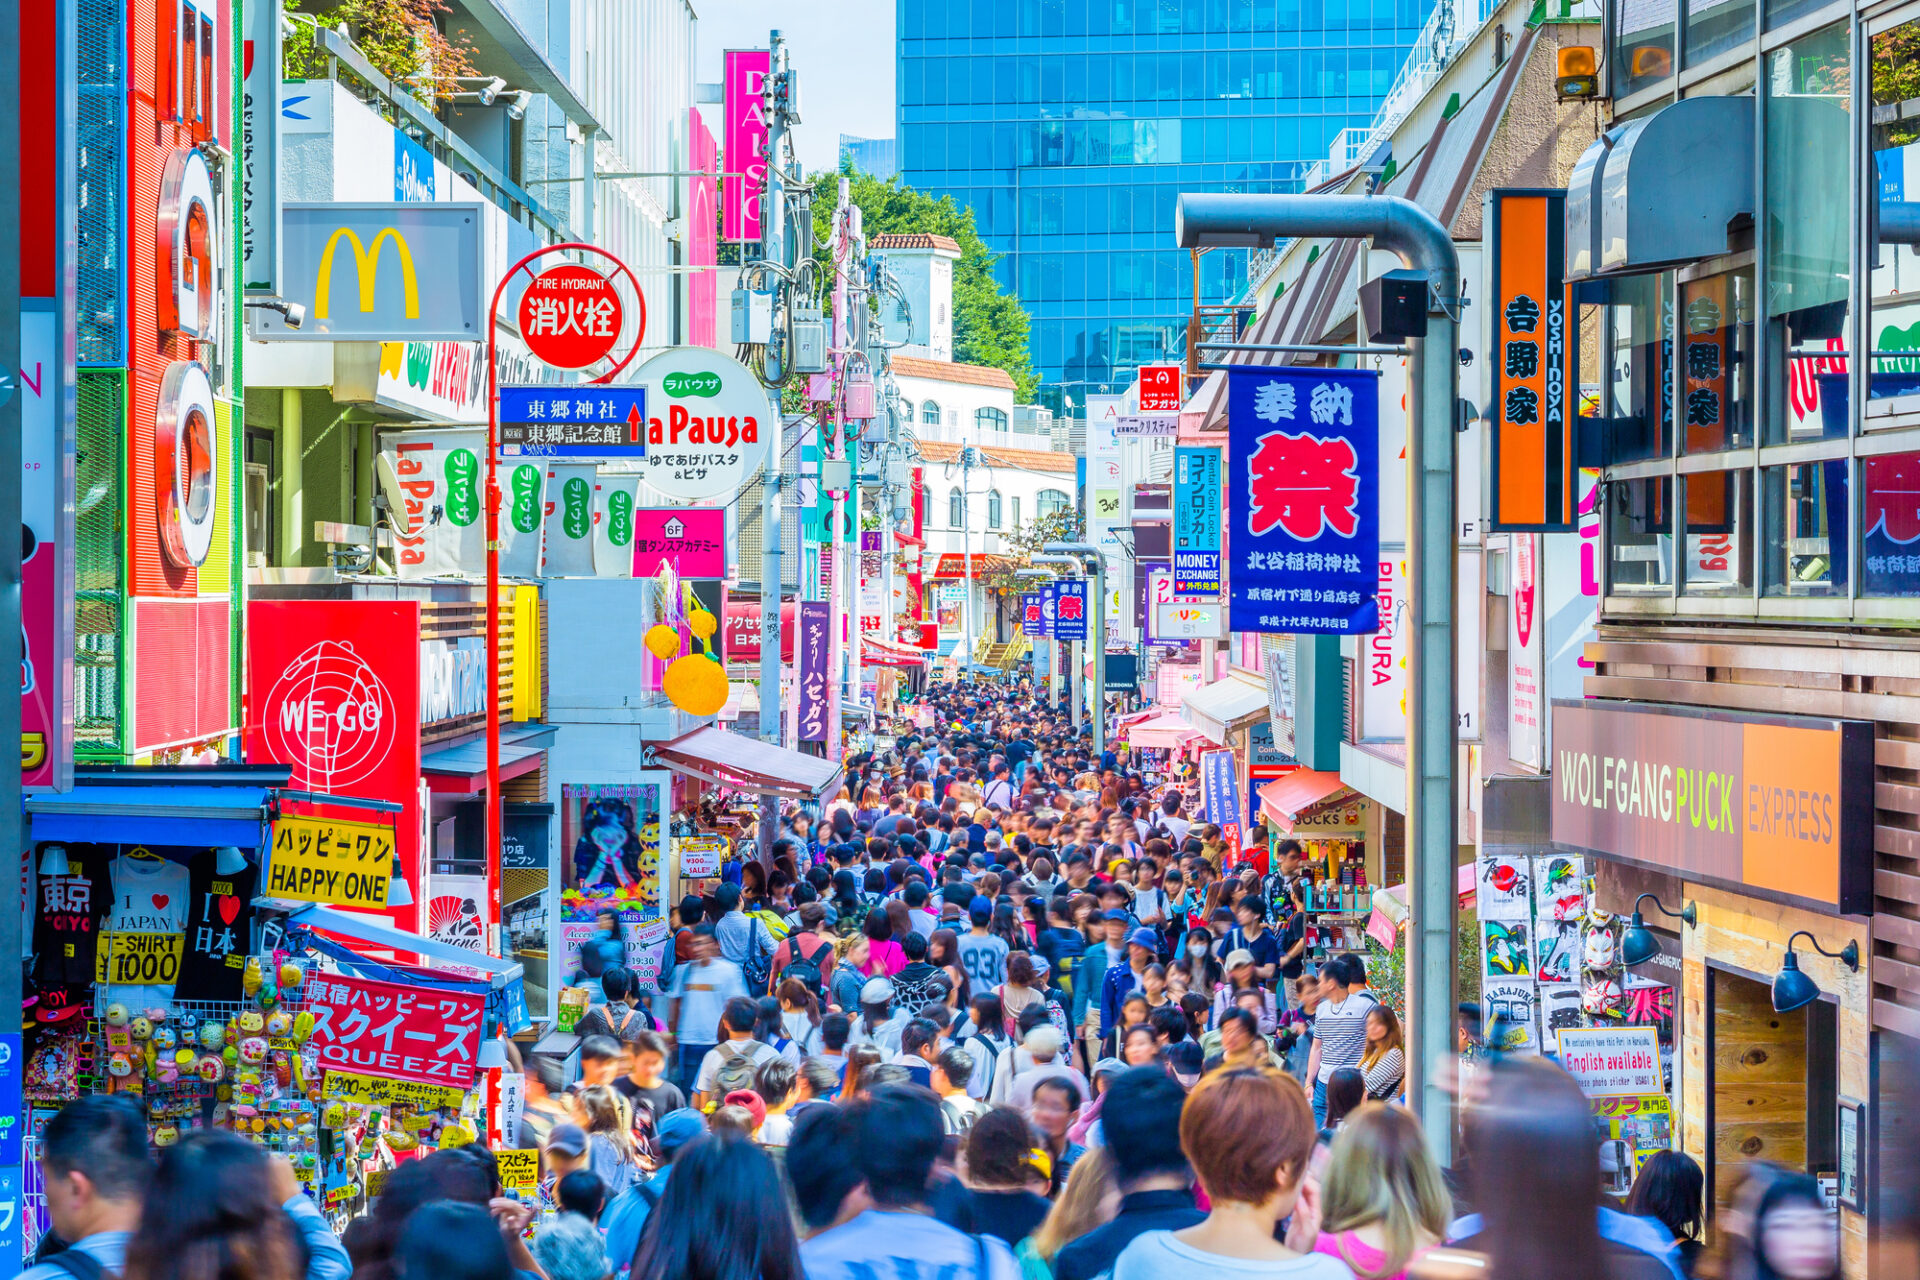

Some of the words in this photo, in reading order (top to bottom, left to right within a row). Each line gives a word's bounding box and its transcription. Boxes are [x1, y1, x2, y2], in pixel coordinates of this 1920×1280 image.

[536, 278, 558, 290] FIRE
[560, 278, 605, 291] HYDRANT
[528, 297, 615, 337] 消火栓
[1548, 300, 1562, 422] YOSHINOYA
[665, 378, 719, 391] ラパウザ
[527, 400, 617, 419] 東郷神社
[1149, 399, 1178, 409] アガサ
[1254, 380, 1354, 426] 奉納
[528, 423, 622, 444] 東郷記念館
[649, 417, 663, 445] a
[669, 404, 758, 448] Pausa
[650, 454, 739, 466] ゆであげパスタ
[674, 469, 708, 480] &ピザ
[1208, 455, 1216, 486] Rental
[453, 452, 471, 524] ラパウザ
[520, 468, 533, 531] ラパウザ
[1192, 455, 1205, 547] コインロッカー
[1208, 489, 1216, 511] Coin
[1247, 430, 1361, 542] 祭
[570, 480, 582, 537] ラパウザ
[615, 493, 625, 545] ラパウザ
[667, 526, 681, 535] 6F
[1208, 514, 1216, 547] Locker
[1177, 554, 1218, 568] MONEY
[1177, 570, 1219, 580] EXCHANGE
[1247, 551, 1361, 574] 北谷稲荷神社
[1247, 588, 1361, 605] 原宿竹下通り商店会
[282, 701, 325, 732] WE
[336, 701, 380, 732] GO
[802, 672, 825, 738] ハセガワ
[1560, 750, 1672, 822] WOLFGANG
[1676, 767, 1734, 834] PUCK
[1749, 784, 1833, 845] EXPRESS
[276, 827, 391, 863] ハッピーワン
[41, 874, 92, 913] 東京
[271, 864, 339, 897] HAPPY
[344, 872, 387, 903] ONE
[123, 895, 131, 909] I
[117, 915, 171, 930] JAPAN
[103, 935, 176, 951] T-SHIRT
[195, 926, 236, 955] 日本
[962, 949, 1000, 979] 93
[306, 980, 479, 1021] 原宿ハッピーワン
[1485, 986, 1535, 1005] HARAJUKU
[307, 1004, 477, 1062] スクイーズ
[307, 1043, 472, 1080] SQUEEZE
[1566, 1052, 1604, 1074] English
[1607, 1050, 1652, 1070] available
[1642, 1099, 1668, 1111] 専門店
